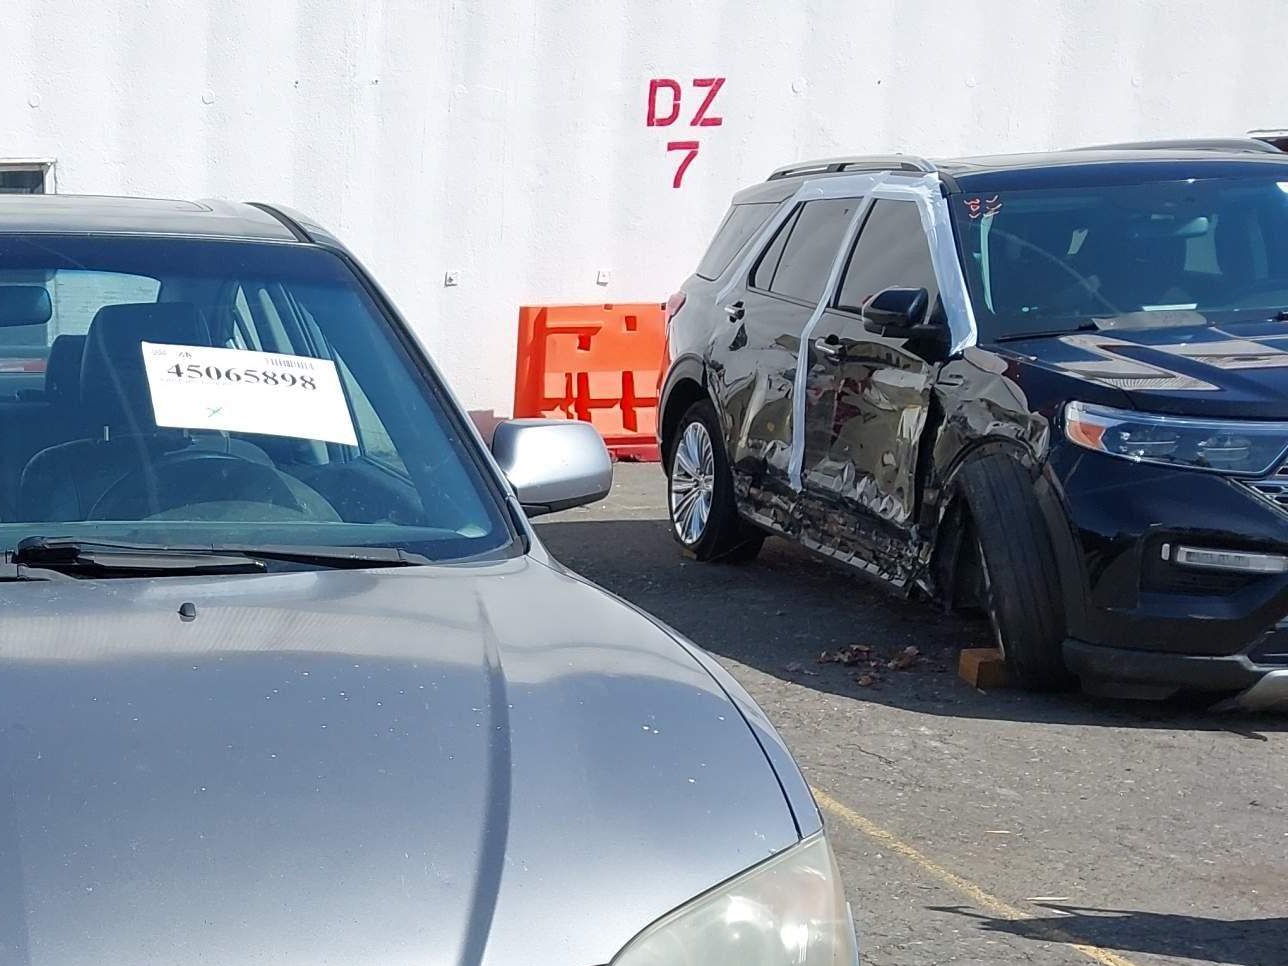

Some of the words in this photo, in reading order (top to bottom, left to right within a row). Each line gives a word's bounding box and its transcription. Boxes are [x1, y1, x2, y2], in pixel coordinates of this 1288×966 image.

[646, 77, 725, 128] DZ
[667, 141, 700, 189] 7
[166, 362, 318, 391] 45065898
